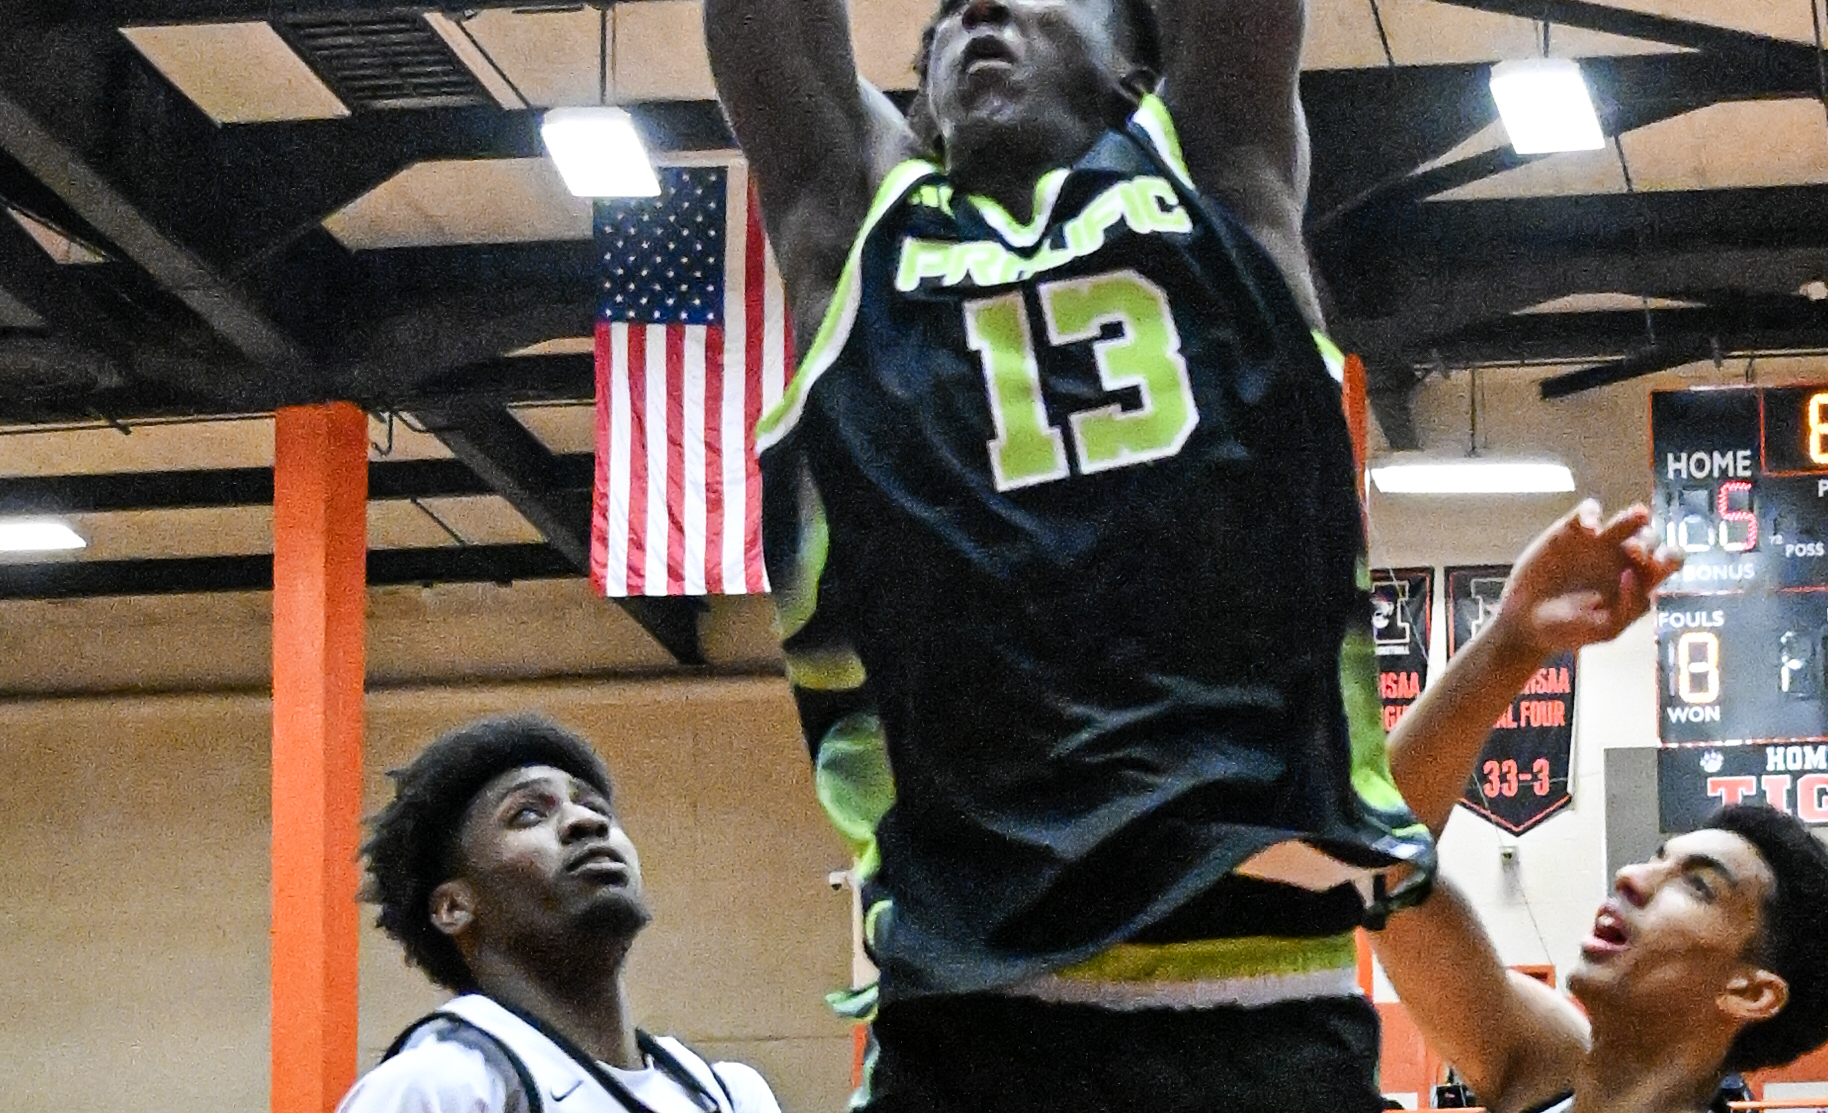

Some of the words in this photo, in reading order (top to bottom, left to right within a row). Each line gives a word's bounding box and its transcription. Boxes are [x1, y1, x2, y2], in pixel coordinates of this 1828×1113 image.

[962, 269, 1200, 492] 13
[1666, 449, 1752, 480] HOME
[1785, 542, 1825, 558] POSS
[1682, 563, 1755, 582] BONUS
[1657, 610, 1725, 628] FOULS
[1520, 700, 1566, 727] FOUR
[1666, 705, 1721, 724] WON
[1483, 758, 1550, 799] 33-3
